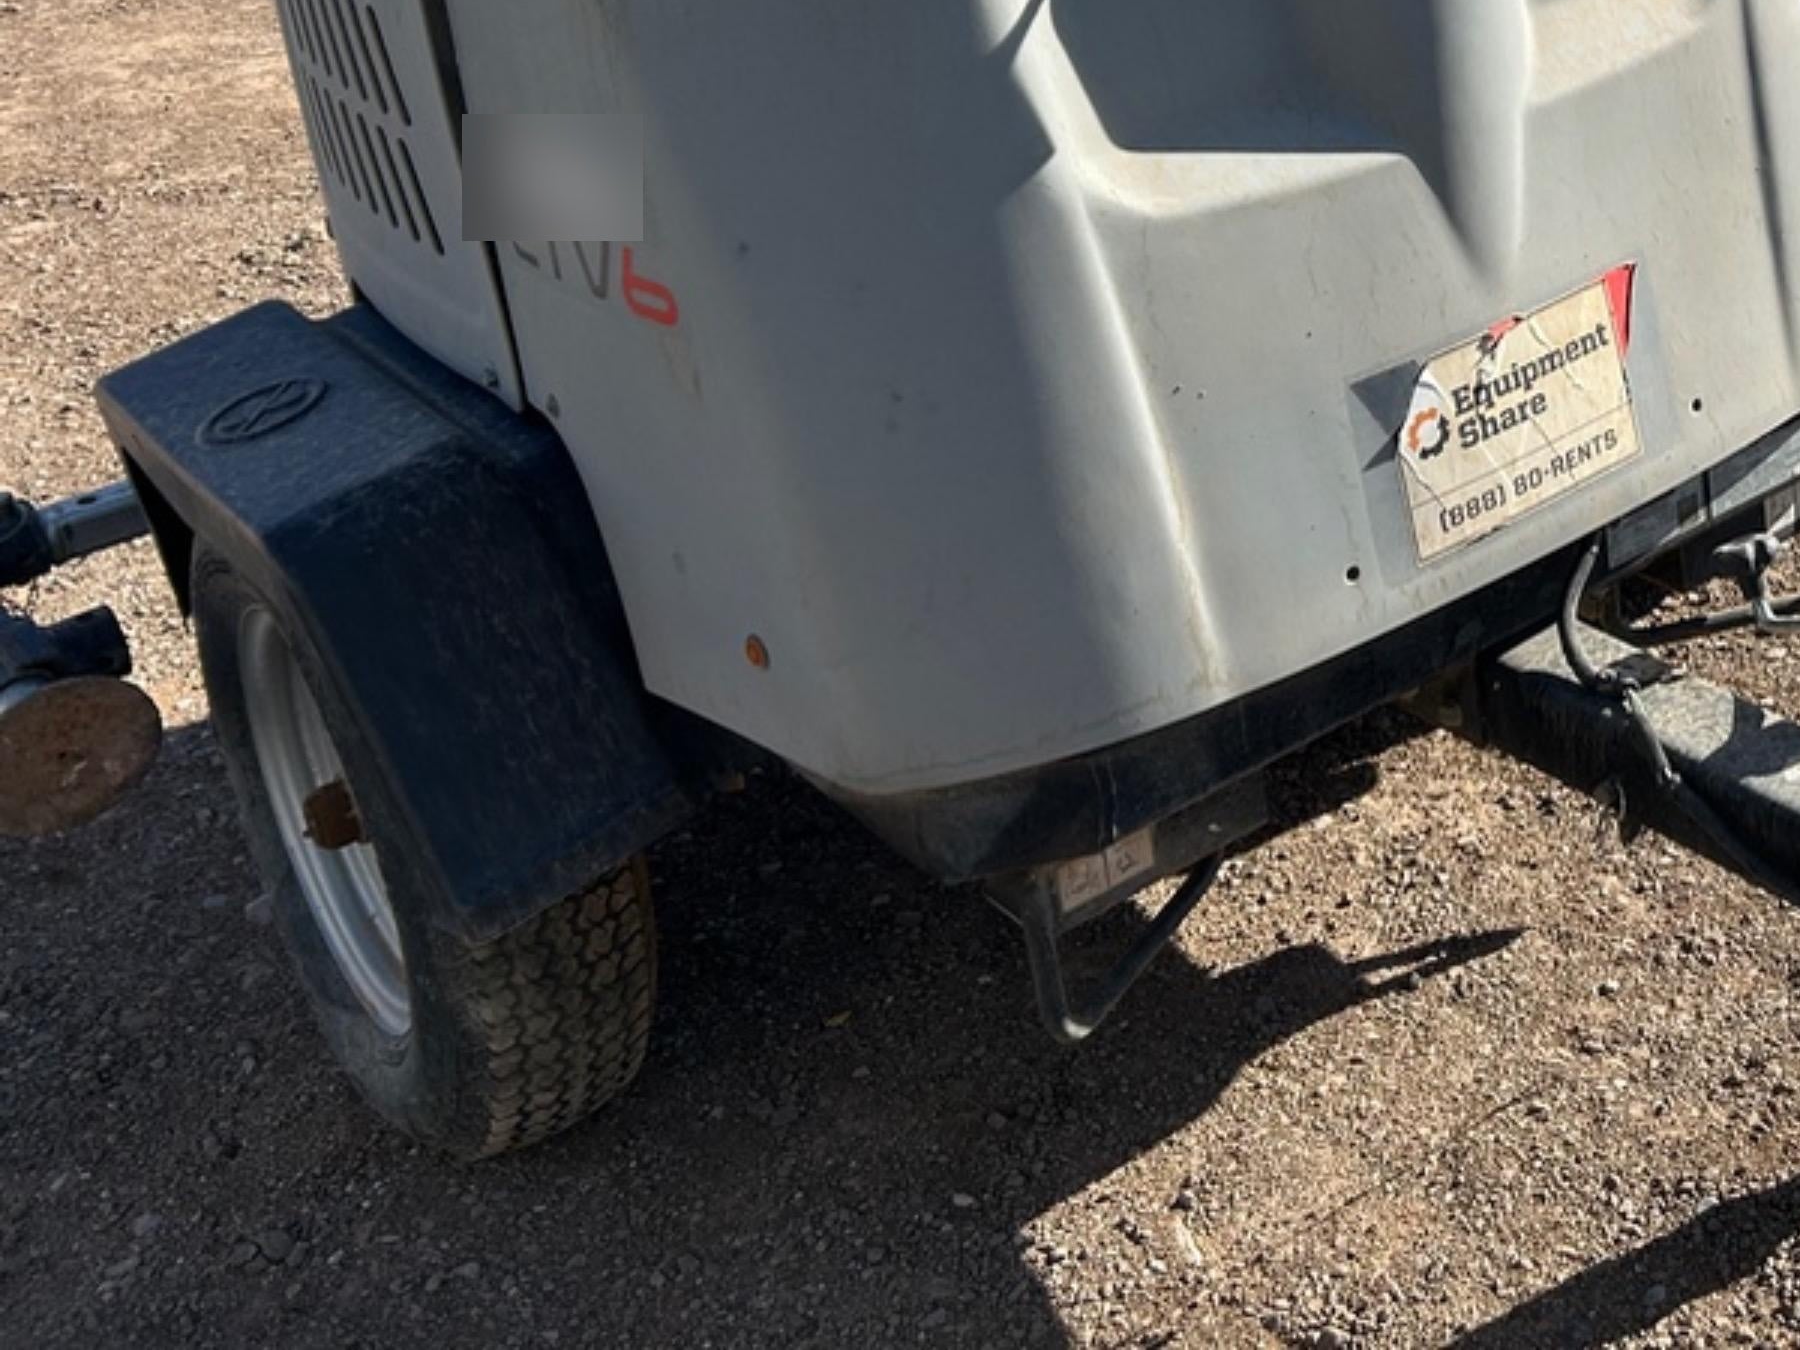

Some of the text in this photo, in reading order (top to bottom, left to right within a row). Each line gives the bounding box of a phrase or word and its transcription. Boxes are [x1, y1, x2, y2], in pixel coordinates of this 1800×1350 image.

[1451, 322, 1609, 418] Equipment
[1457, 392, 1547, 449] Share
[1440, 428, 1618, 533] (888) 80-RENTS
